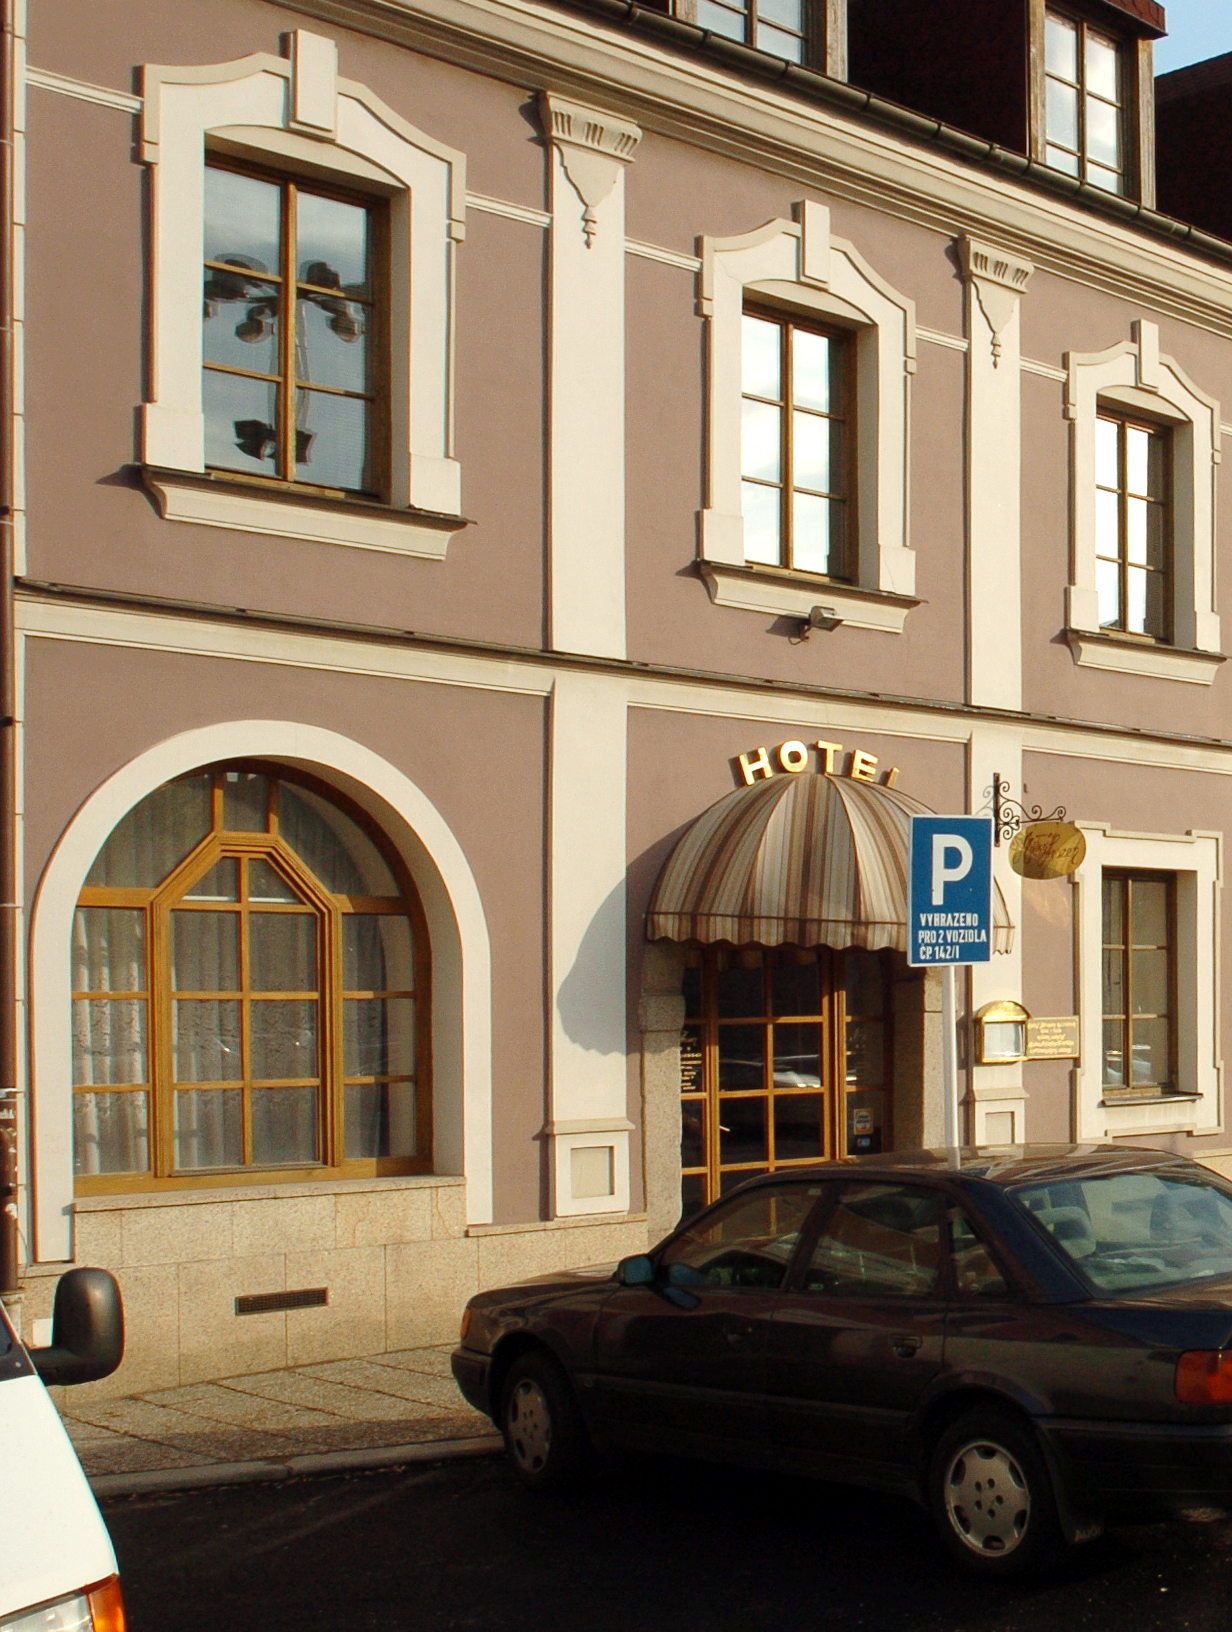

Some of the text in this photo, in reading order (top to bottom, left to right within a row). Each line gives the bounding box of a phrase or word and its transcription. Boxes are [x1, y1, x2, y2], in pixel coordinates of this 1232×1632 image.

[932, 834, 972, 905] P
[919, 912, 979, 927] VYHRAZENO
[918, 928, 988, 944] PRO 2 VOZIDLA
